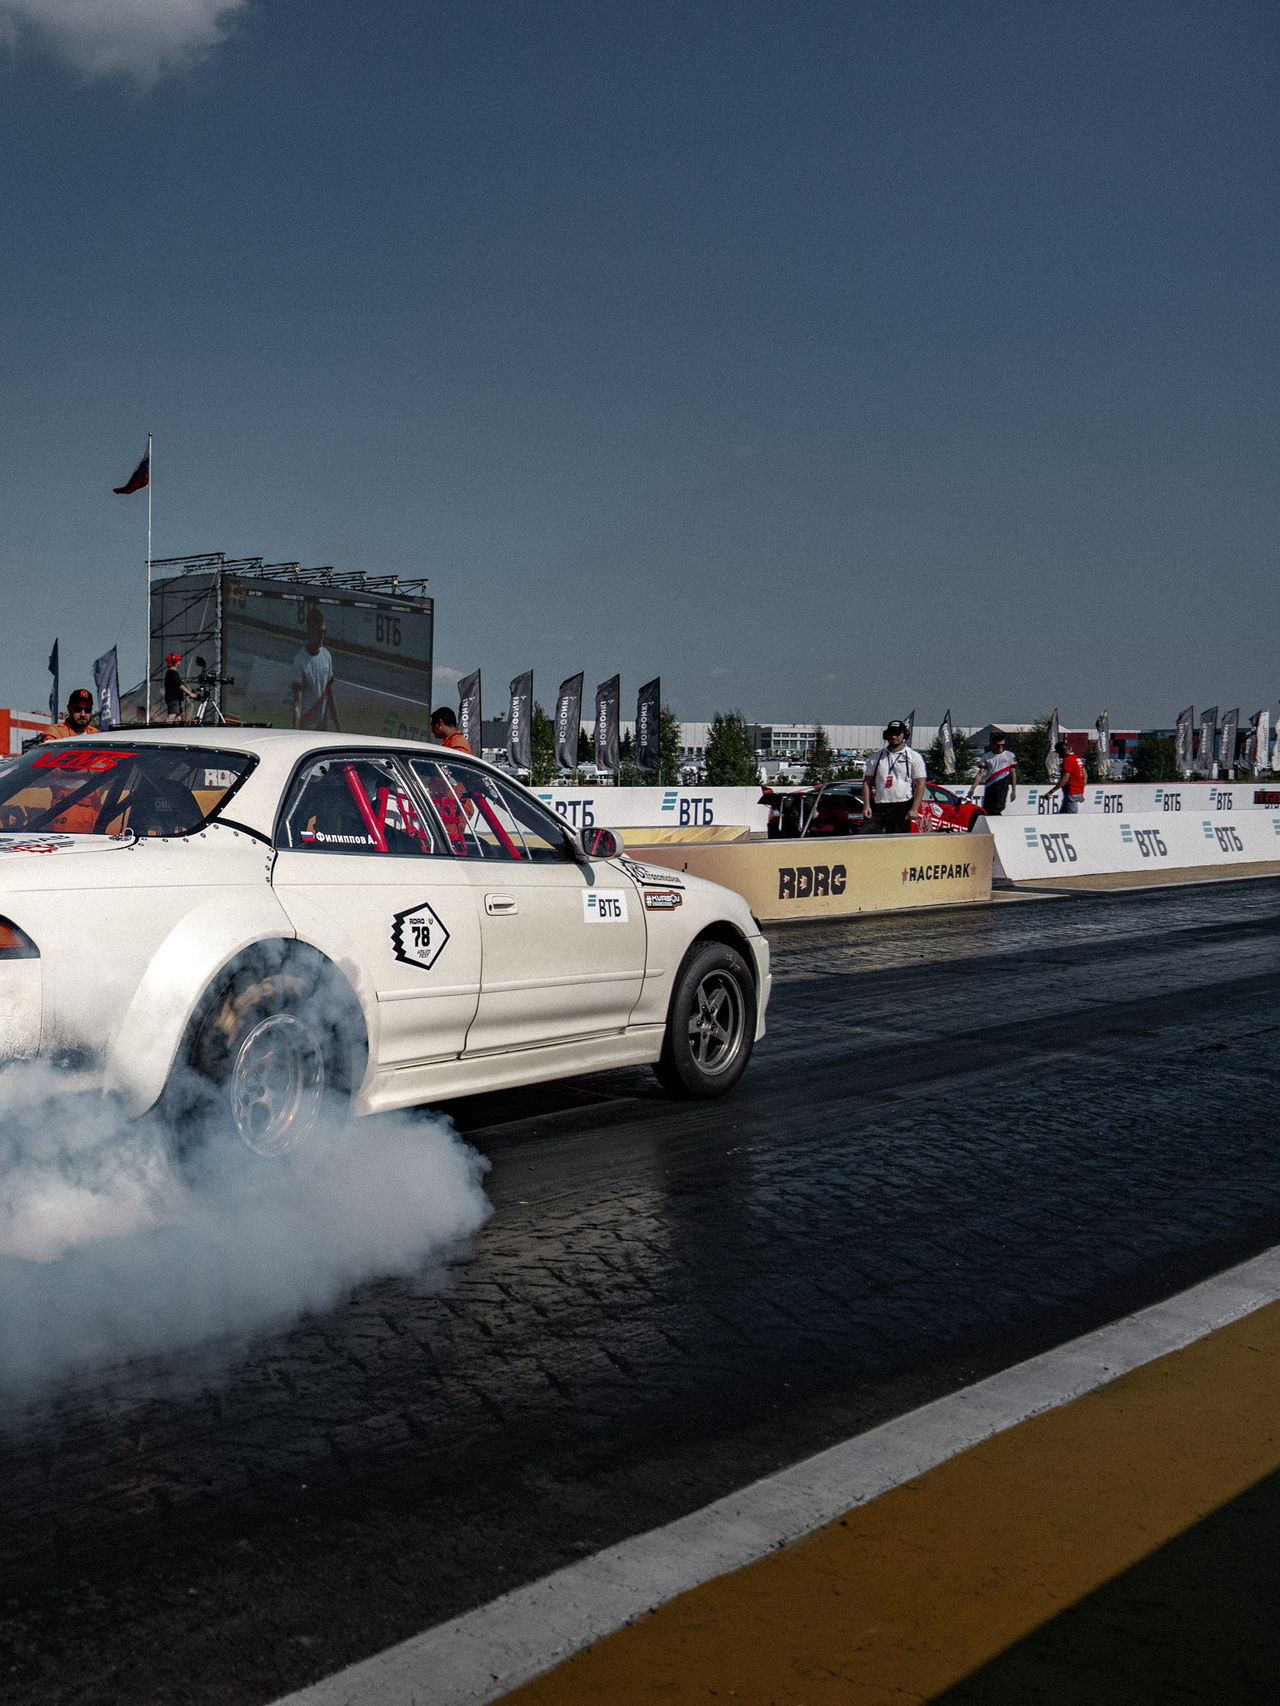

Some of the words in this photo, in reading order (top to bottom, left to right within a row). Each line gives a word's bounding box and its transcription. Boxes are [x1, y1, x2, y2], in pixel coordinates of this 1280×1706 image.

[376, 613, 402, 647] ВТБ
[30, 750, 139, 771] VEMS
[1038, 794, 1059, 815] ВТБ
[1104, 794, 1123, 813] ВТБ
[1163, 793, 1181, 811] ВТБ
[1216, 792, 1233, 810] ВТБ
[680, 798, 714, 826] ВТБ
[315, 831, 367, 844] Филиппов
[1040, 832, 1078, 863] ВТБ
[1134, 829, 1168, 857] ВТБ
[1214, 826, 1244, 853] ВТБ
[778, 864, 847, 900] RDRC
[909, 863, 970, 882] RACEPARK
[598, 899, 622, 918] ВТБ
[411, 926, 431, 947] 78
